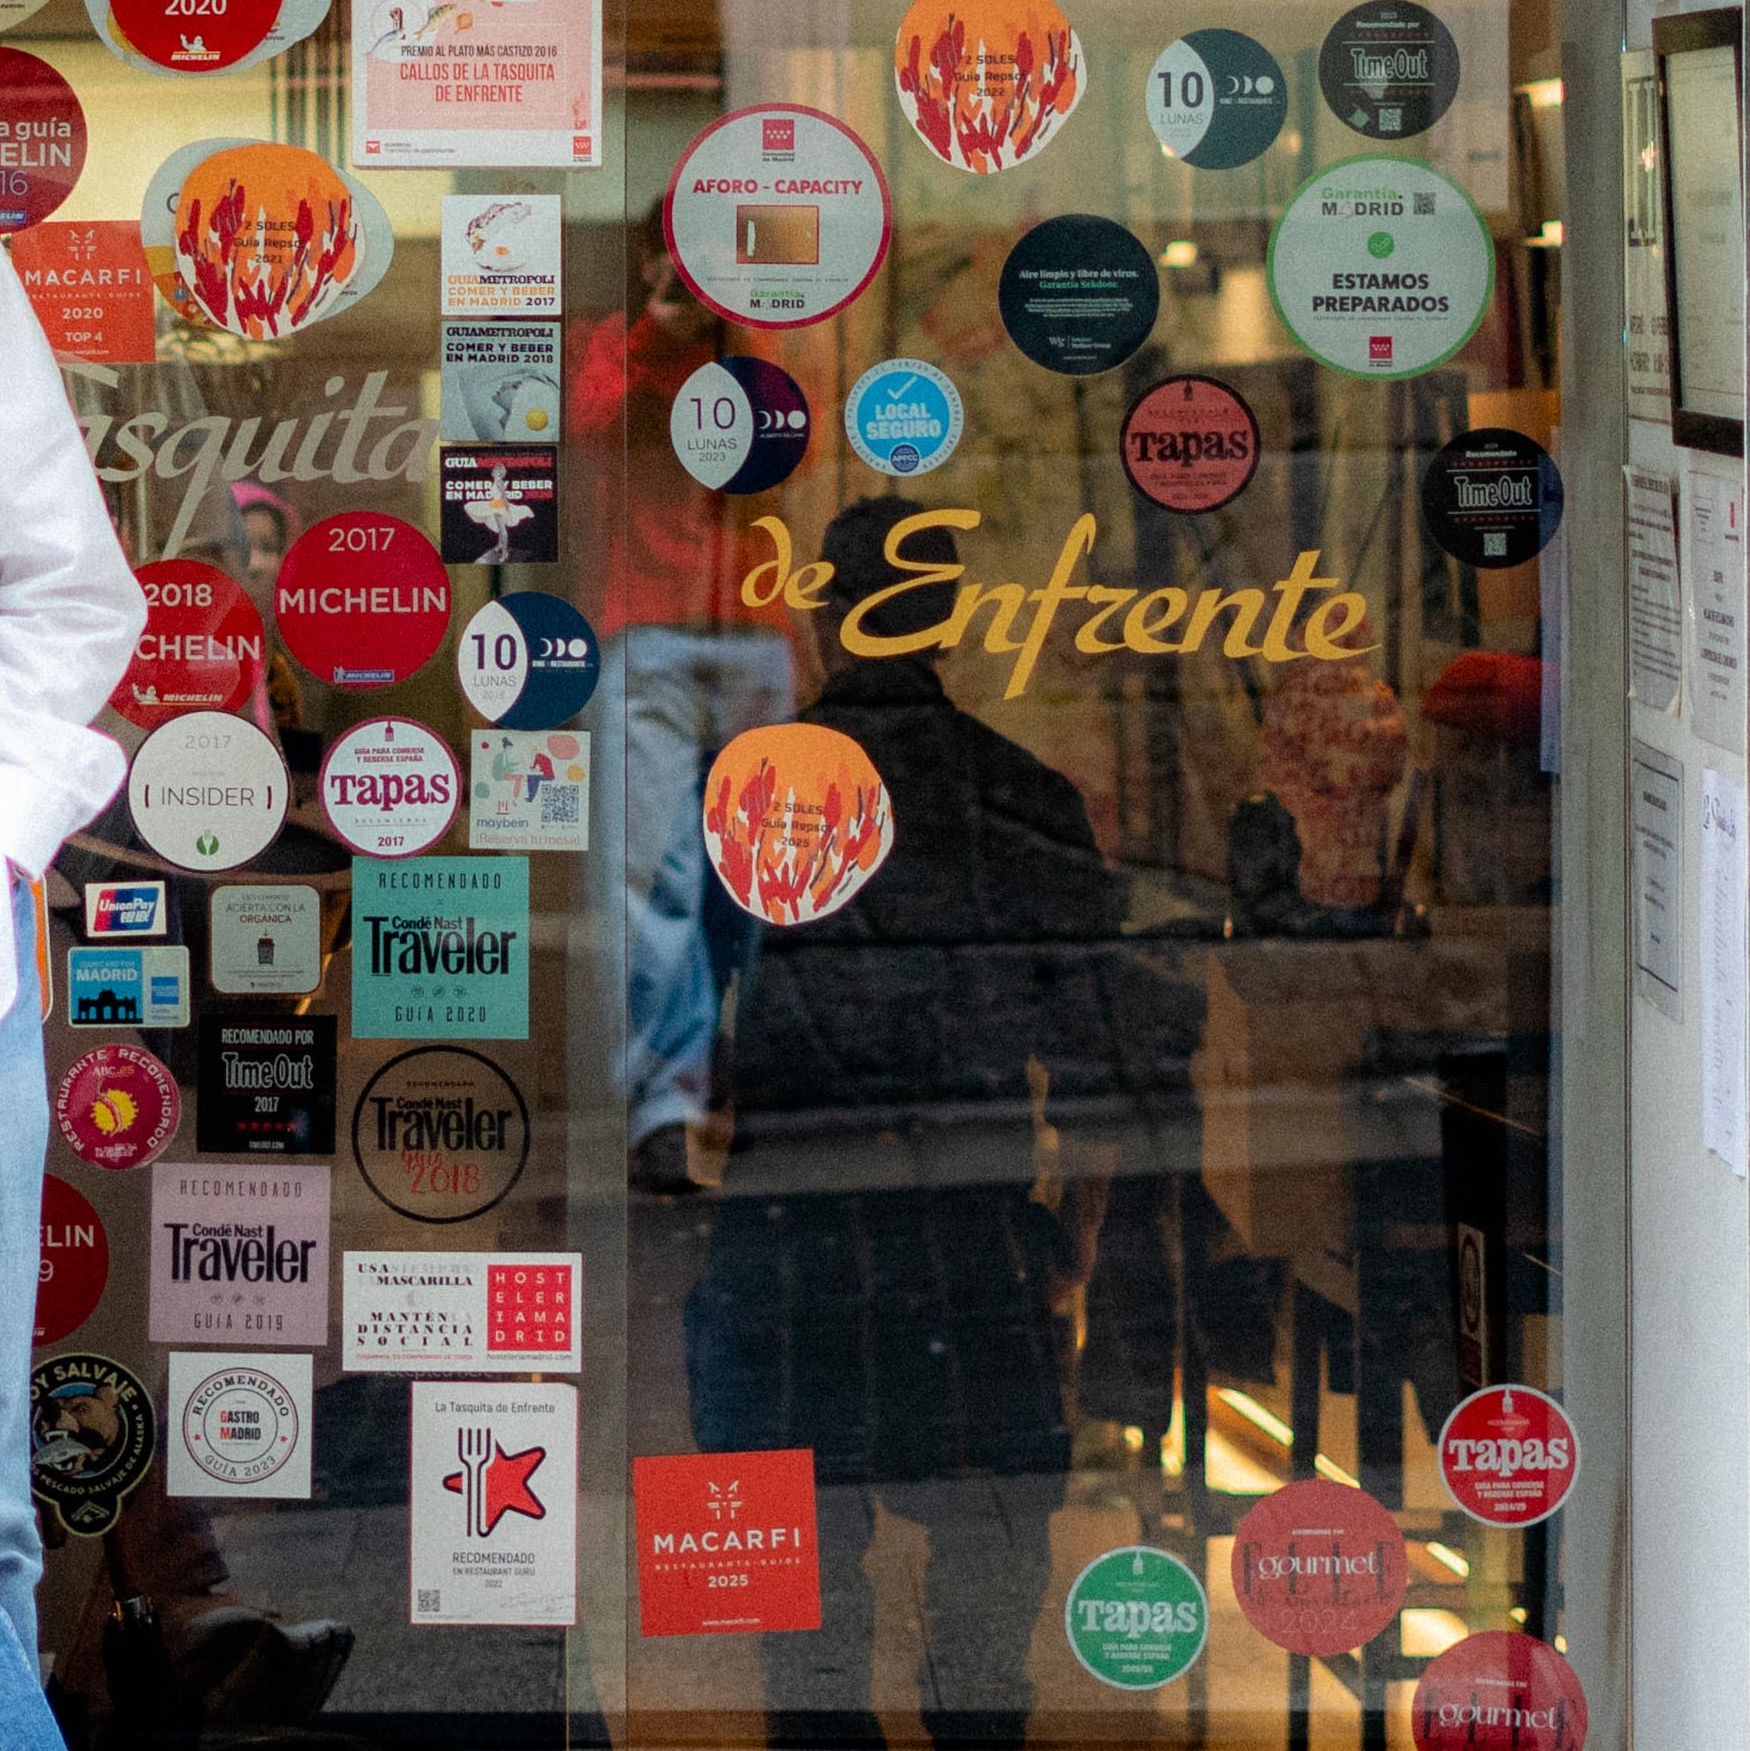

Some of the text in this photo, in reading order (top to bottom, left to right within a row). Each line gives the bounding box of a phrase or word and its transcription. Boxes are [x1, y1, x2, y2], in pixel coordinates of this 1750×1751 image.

[401, 43, 557, 57] PREMIO AL PLATO MÁS CASTIZO 2016
[976, 54, 1016, 65] SOLES
[400, 63, 555, 81] CALLOS DE LA TASQUITA
[436, 85, 522, 102] DE ENFRENTE
[1157, 71, 1204, 108] 10
[1160, 113, 1204, 125] LUNAS
[15, 117, 71, 140] guía
[692, 178, 863, 195] AFORO CAPACITY
[255, 254, 283, 264] 2021
[24, 268, 142, 286] MACARFI
[447, 274, 555, 284] GUIAMETROPOLI
[1019, 269, 1099, 280] Aire limpio libre
[1332, 273, 1430, 290] ESTAMOS
[448, 287, 555, 296] COMER BEBER
[447, 297, 555, 306] EN MADRID 2017
[1312, 296, 1450, 313] PREPARADOS
[62, 307, 104, 319] 2020
[64, 332, 103, 343] TOP 4
[446, 327, 554, 337] GUIAMETROPOLI
[446, 343, 554, 352] COMER Y BEBER
[446, 353, 554, 363] EN MADRID 2018
[690, 397, 736, 430] 10
[875, 402, 932, 420] LOCAL
[865, 418, 942, 440] SEGURO
[687, 437, 737, 450] LUNAS
[1130, 430, 1249, 467] Tapas
[698, 452, 727, 462] 2023
[445, 480, 553, 490] COMER BEBER
[445, 491, 463, 500] EN
[328, 527, 396, 552] 2017
[141, 583, 213, 607] 2018
[279, 586, 447, 614] MICHELIN
[740, 508, 1381, 701] de Enfrente
[471, 633, 517, 670] 10
[473, 675, 517, 687] LUNAS
[162, 693, 224, 703] MICHELIN
[184, 734, 232, 749] 2017
[161, 786, 255, 807] INSIDER
[330, 773, 450, 811] Tapas
[784, 801, 824, 815] SOLES
[477, 816, 529, 829] maybein
[760, 818, 787, 829] Guía
[377, 836, 405, 847] 2017
[781, 838, 810, 848] 2025
[379, 872, 502, 889] RECOMENDADO
[99, 897, 155, 912] UnionPay
[225, 903, 291, 912] ACIERTA CON
[239, 913, 292, 924] ORGÁNICA
[392, 915, 463, 930] Condé Nast
[363, 916, 517, 975] Traveler
[76, 969, 138, 981] MADRID
[395, 1006, 486, 1023] GUÍA 2020
[221, 1028, 314, 1045] RECOMENDADO POR
[57, 1048, 172, 1152] RESTAURANTE RECOMENDADO
[254, 1096, 280, 1113] 2017
[369, 1097, 513, 1151] Traveler
[410, 1162, 481, 1195] 2018
[180, 1179, 303, 1198] RECOMENDADO
[192, 1223, 264, 1238] Condé Nast
[163, 1223, 317, 1284] Traveler
[357, 1263, 390, 1274] USA
[376, 1275, 473, 1286] MASCARILLA
[495, 1292, 565, 1303] ELER
[194, 1313, 283, 1331] GUÍA 2019
[370, 1310, 448, 1322] MANTÉN
[495, 1311, 566, 1323] IAMA
[357, 1324, 473, 1334] DISTANCIA
[495, 1330, 566, 1342] DRID
[356, 1336, 473, 1346] SOCIAL
[53, 1361, 139, 1403] SALVAJE
[192, 1375, 290, 1417] RECOMENDADO
[435, 1402, 555, 1415] La Tasquita de Enfrente
[219, 1410, 260, 1424] GASTRO
[219, 1427, 262, 1441] MADRID
[1448, 1437, 1570, 1478] Tapas
[204, 1454, 278, 1477] GUÍA 2023
[653, 1527, 801, 1554] MACARFI
[452, 1552, 535, 1564] RECOMENDADO
[452, 1567, 536, 1576] EN RESTAURANT GURU
[1257, 1551, 1379, 1581] gourmet
[707, 1574, 749, 1588] 2025
[1078, 1600, 1198, 1639] Tapas
[1438, 1702, 1558, 1730] gourmet
